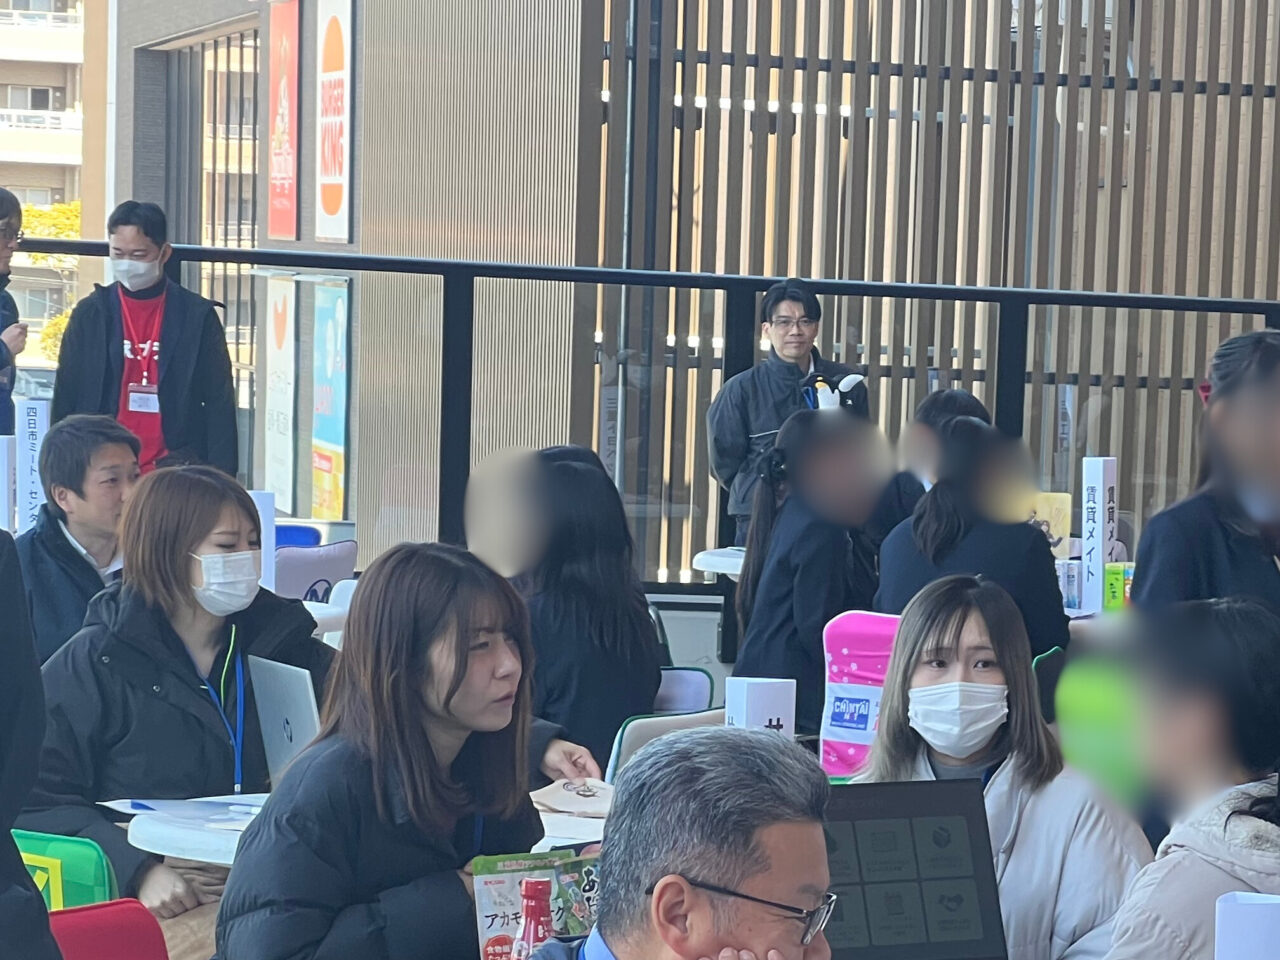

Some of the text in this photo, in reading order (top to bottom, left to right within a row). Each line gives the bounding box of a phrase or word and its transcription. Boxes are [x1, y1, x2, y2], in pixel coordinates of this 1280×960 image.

[1085, 486, 1098, 582] 賃貸メイト
[1106, 486, 1117, 563] 賃貸メイ
[484, 907, 565, 930] アカモク
